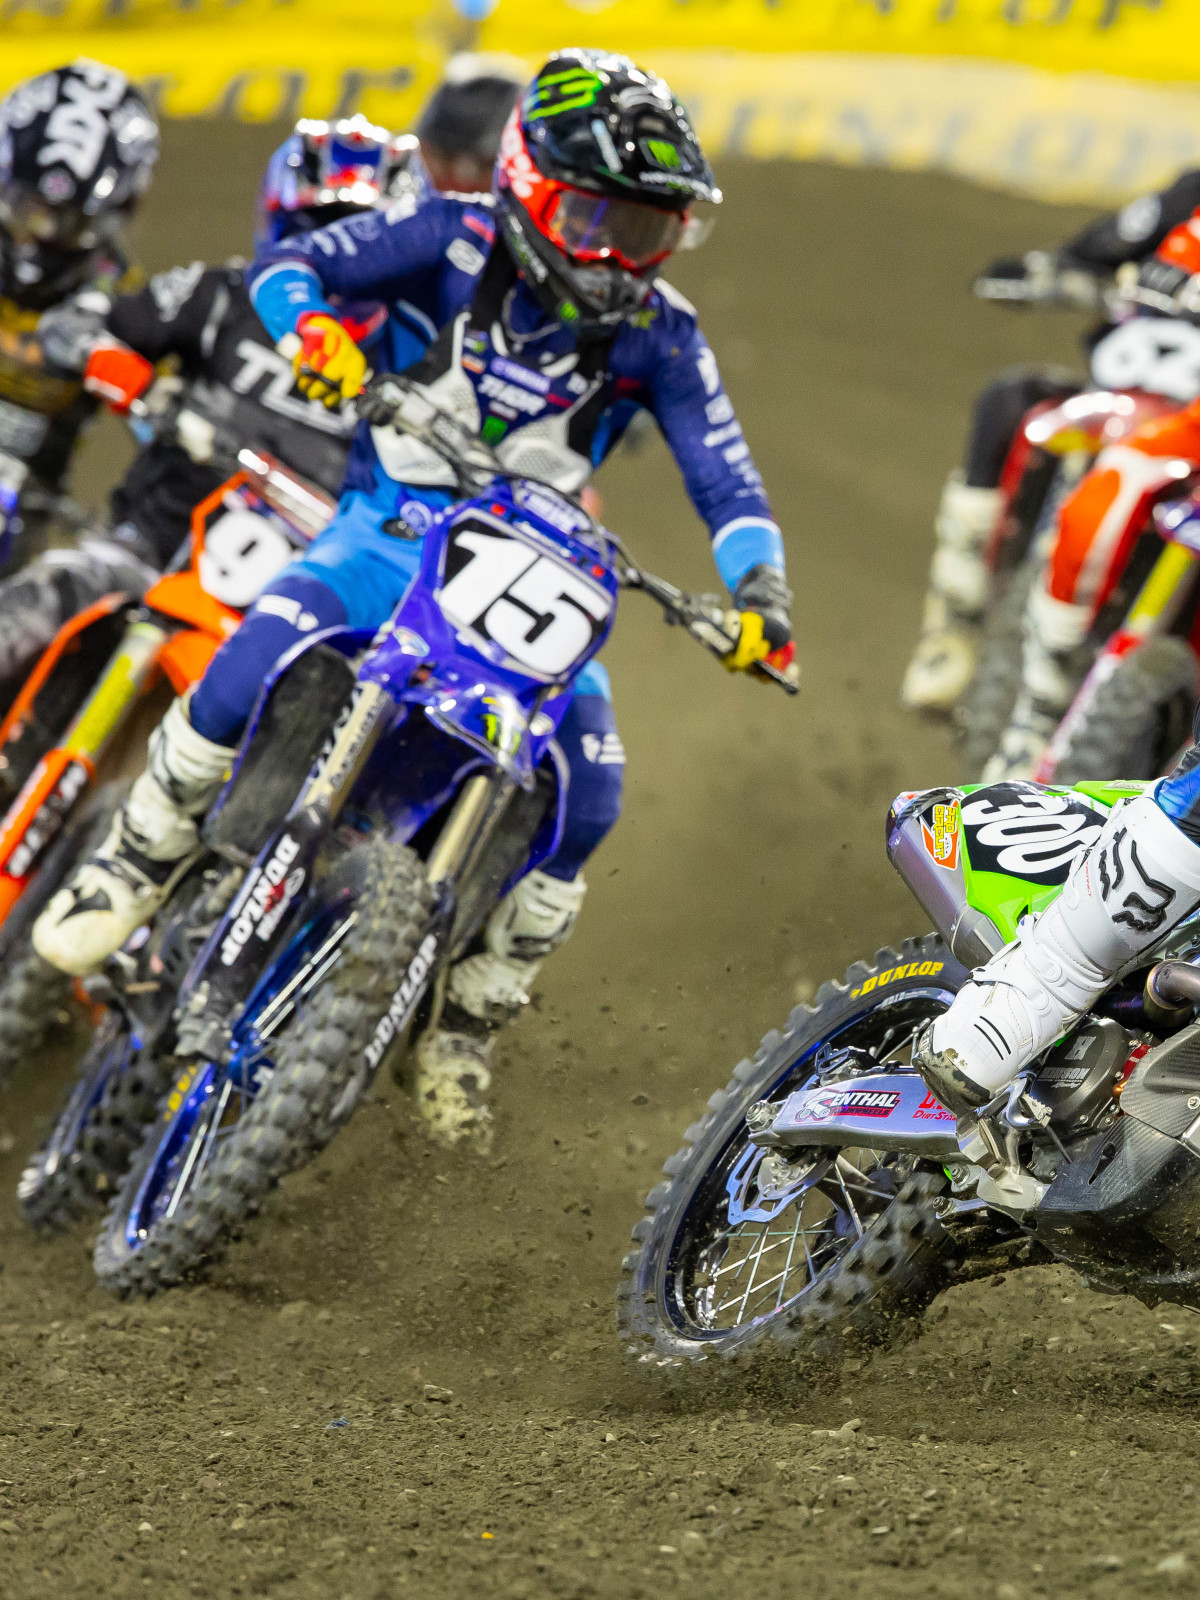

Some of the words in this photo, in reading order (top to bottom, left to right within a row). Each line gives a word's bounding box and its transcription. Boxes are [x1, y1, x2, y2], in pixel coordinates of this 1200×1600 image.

[436, 529, 613, 675] 15
[934, 805, 946, 859] CIRCUIT
[945, 806, 957, 834] PRO
[961, 794, 1103, 874] 300
[220, 833, 300, 967] DUNLOP
[363, 933, 438, 1068] DUNLOP
[860, 961, 944, 996] DUNLOP
[912, 1109, 936, 1119] DIRT
